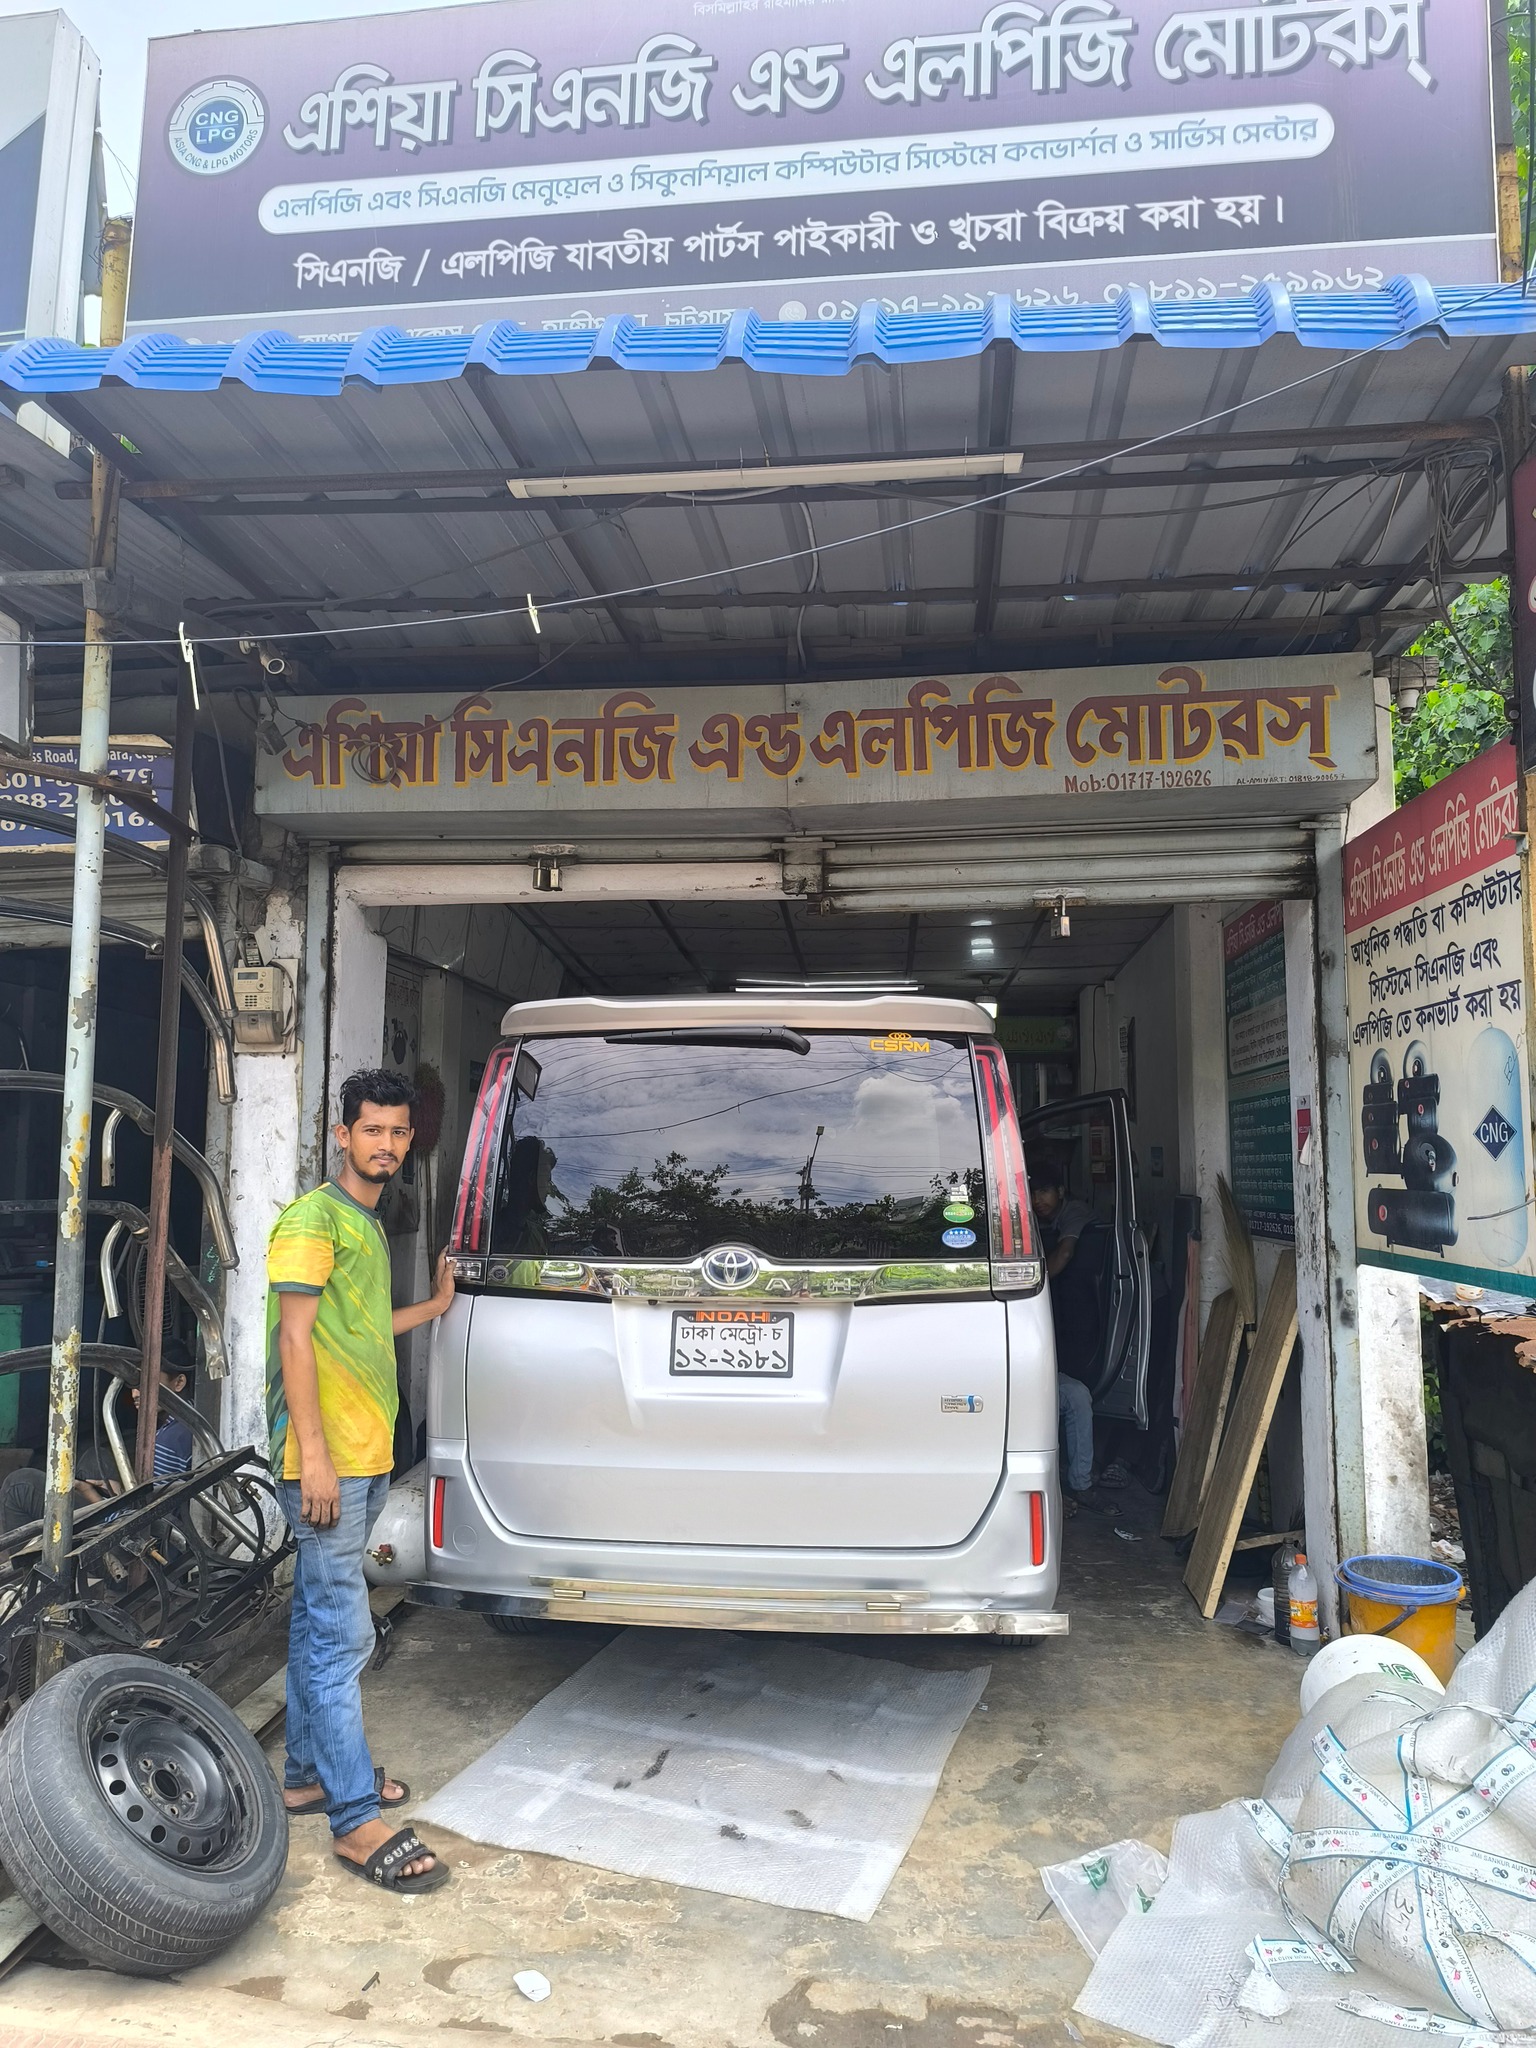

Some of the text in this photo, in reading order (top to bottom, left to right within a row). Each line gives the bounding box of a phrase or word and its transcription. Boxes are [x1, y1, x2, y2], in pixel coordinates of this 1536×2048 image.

[283, 62, 459, 154] এশিয়া
[471, 33, 715, 138] সিএনজি
[864, 3, 1134, 104] এলপিজি
[195, 109, 239, 127] CNG
[173, 128, 258, 169] ASIA CNG & LPG MOTORS
[195, 127, 236, 145] LPG
[273, 115, 1319, 218] এলপিজি এবং সিএনজি মেনুয়েল ও সিকুনশিয়াল কম্পিউটার সিস্টেমে কনভার্শন ও সার্ভিস সেন্টার
[293, 247, 406, 289] সিএনজি
[412, 248, 431, 287] /
[441, 237, 558, 279] এলপিজি
[562, 228, 675, 270] যাবতীয়
[683, 222, 764, 262] পার্টস
[773, 210, 901, 256] পাইকারী
[910, 220, 940, 245] ও
[949, 209, 1028, 252] খুচরা
[1034, 199, 1130, 240] বিক্রয়
[1135, 195, 1205, 231] করা
[1210, 194, 1266, 228] হয়
[282, 697, 442, 790] এশিয়া
[450, 690, 679, 785] সিএনজি
[810, 676, 1056, 776] এলপিজি
[1066, 666, 1339, 768] মোটরস্
[45, 749, 78, 765] Road,
[1371, 831, 1407, 907] সিএনজি
[1429, 792, 1471, 877] এলপিজি
[1351, 869, 1522, 968] আধুনিক পদ্ধতি বা কম্পিউটার
[1368, 937, 1502, 1005] সিস্টেমে সিএনজি এবং
[1353, 979, 1522, 1048] এলপিজি তে কনভার্ট করা হয়
[870, 1039, 930, 1053] CSRM
[1480, 1120, 1510, 1145] CNG
[699, 1311, 767, 1323] NOAH
[681, 1325, 714, 1341] ঢাকা
[772, 1327, 784, 1341] চ
[676, 1348, 787, 1370] ১২-২৯৮১
[1382, 1833, 1409, 1841] SANKUR
[1483, 1855, 1510, 1868] SANKUR
[1511, 1864, 1528, 1873] AUTO
